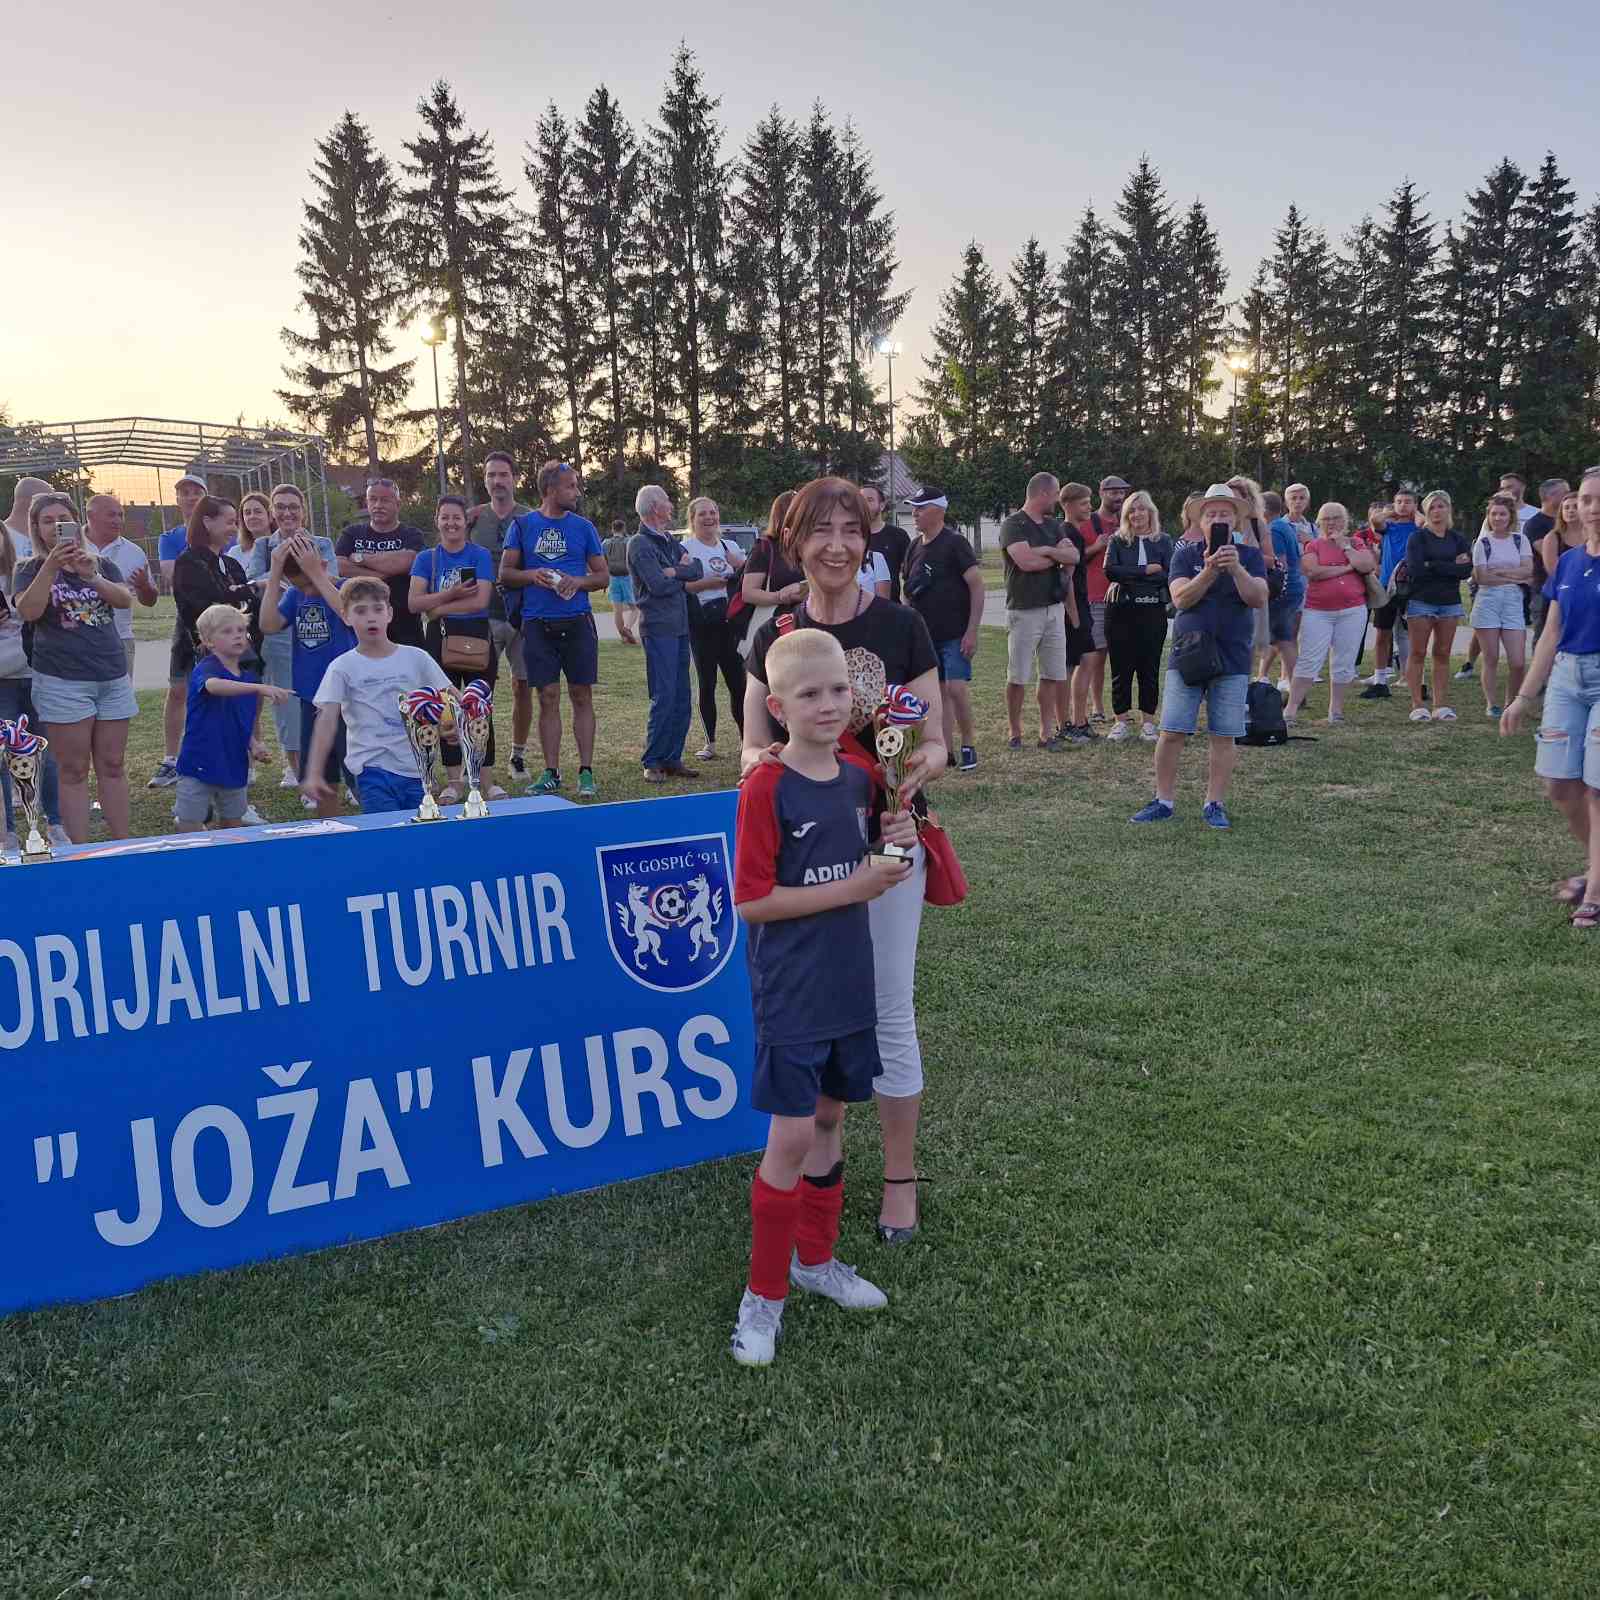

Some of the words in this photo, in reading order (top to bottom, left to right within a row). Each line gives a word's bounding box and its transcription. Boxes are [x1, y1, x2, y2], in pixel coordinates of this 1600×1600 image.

[611, 861, 636, 877] NK
[639, 851, 694, 873] GOSPIĆ
[697, 851, 720, 865] '91
[0, 904, 310, 1049] ORIJALNI
[347, 872, 575, 991] TURNIR
[472, 1015, 738, 1167] KURS
